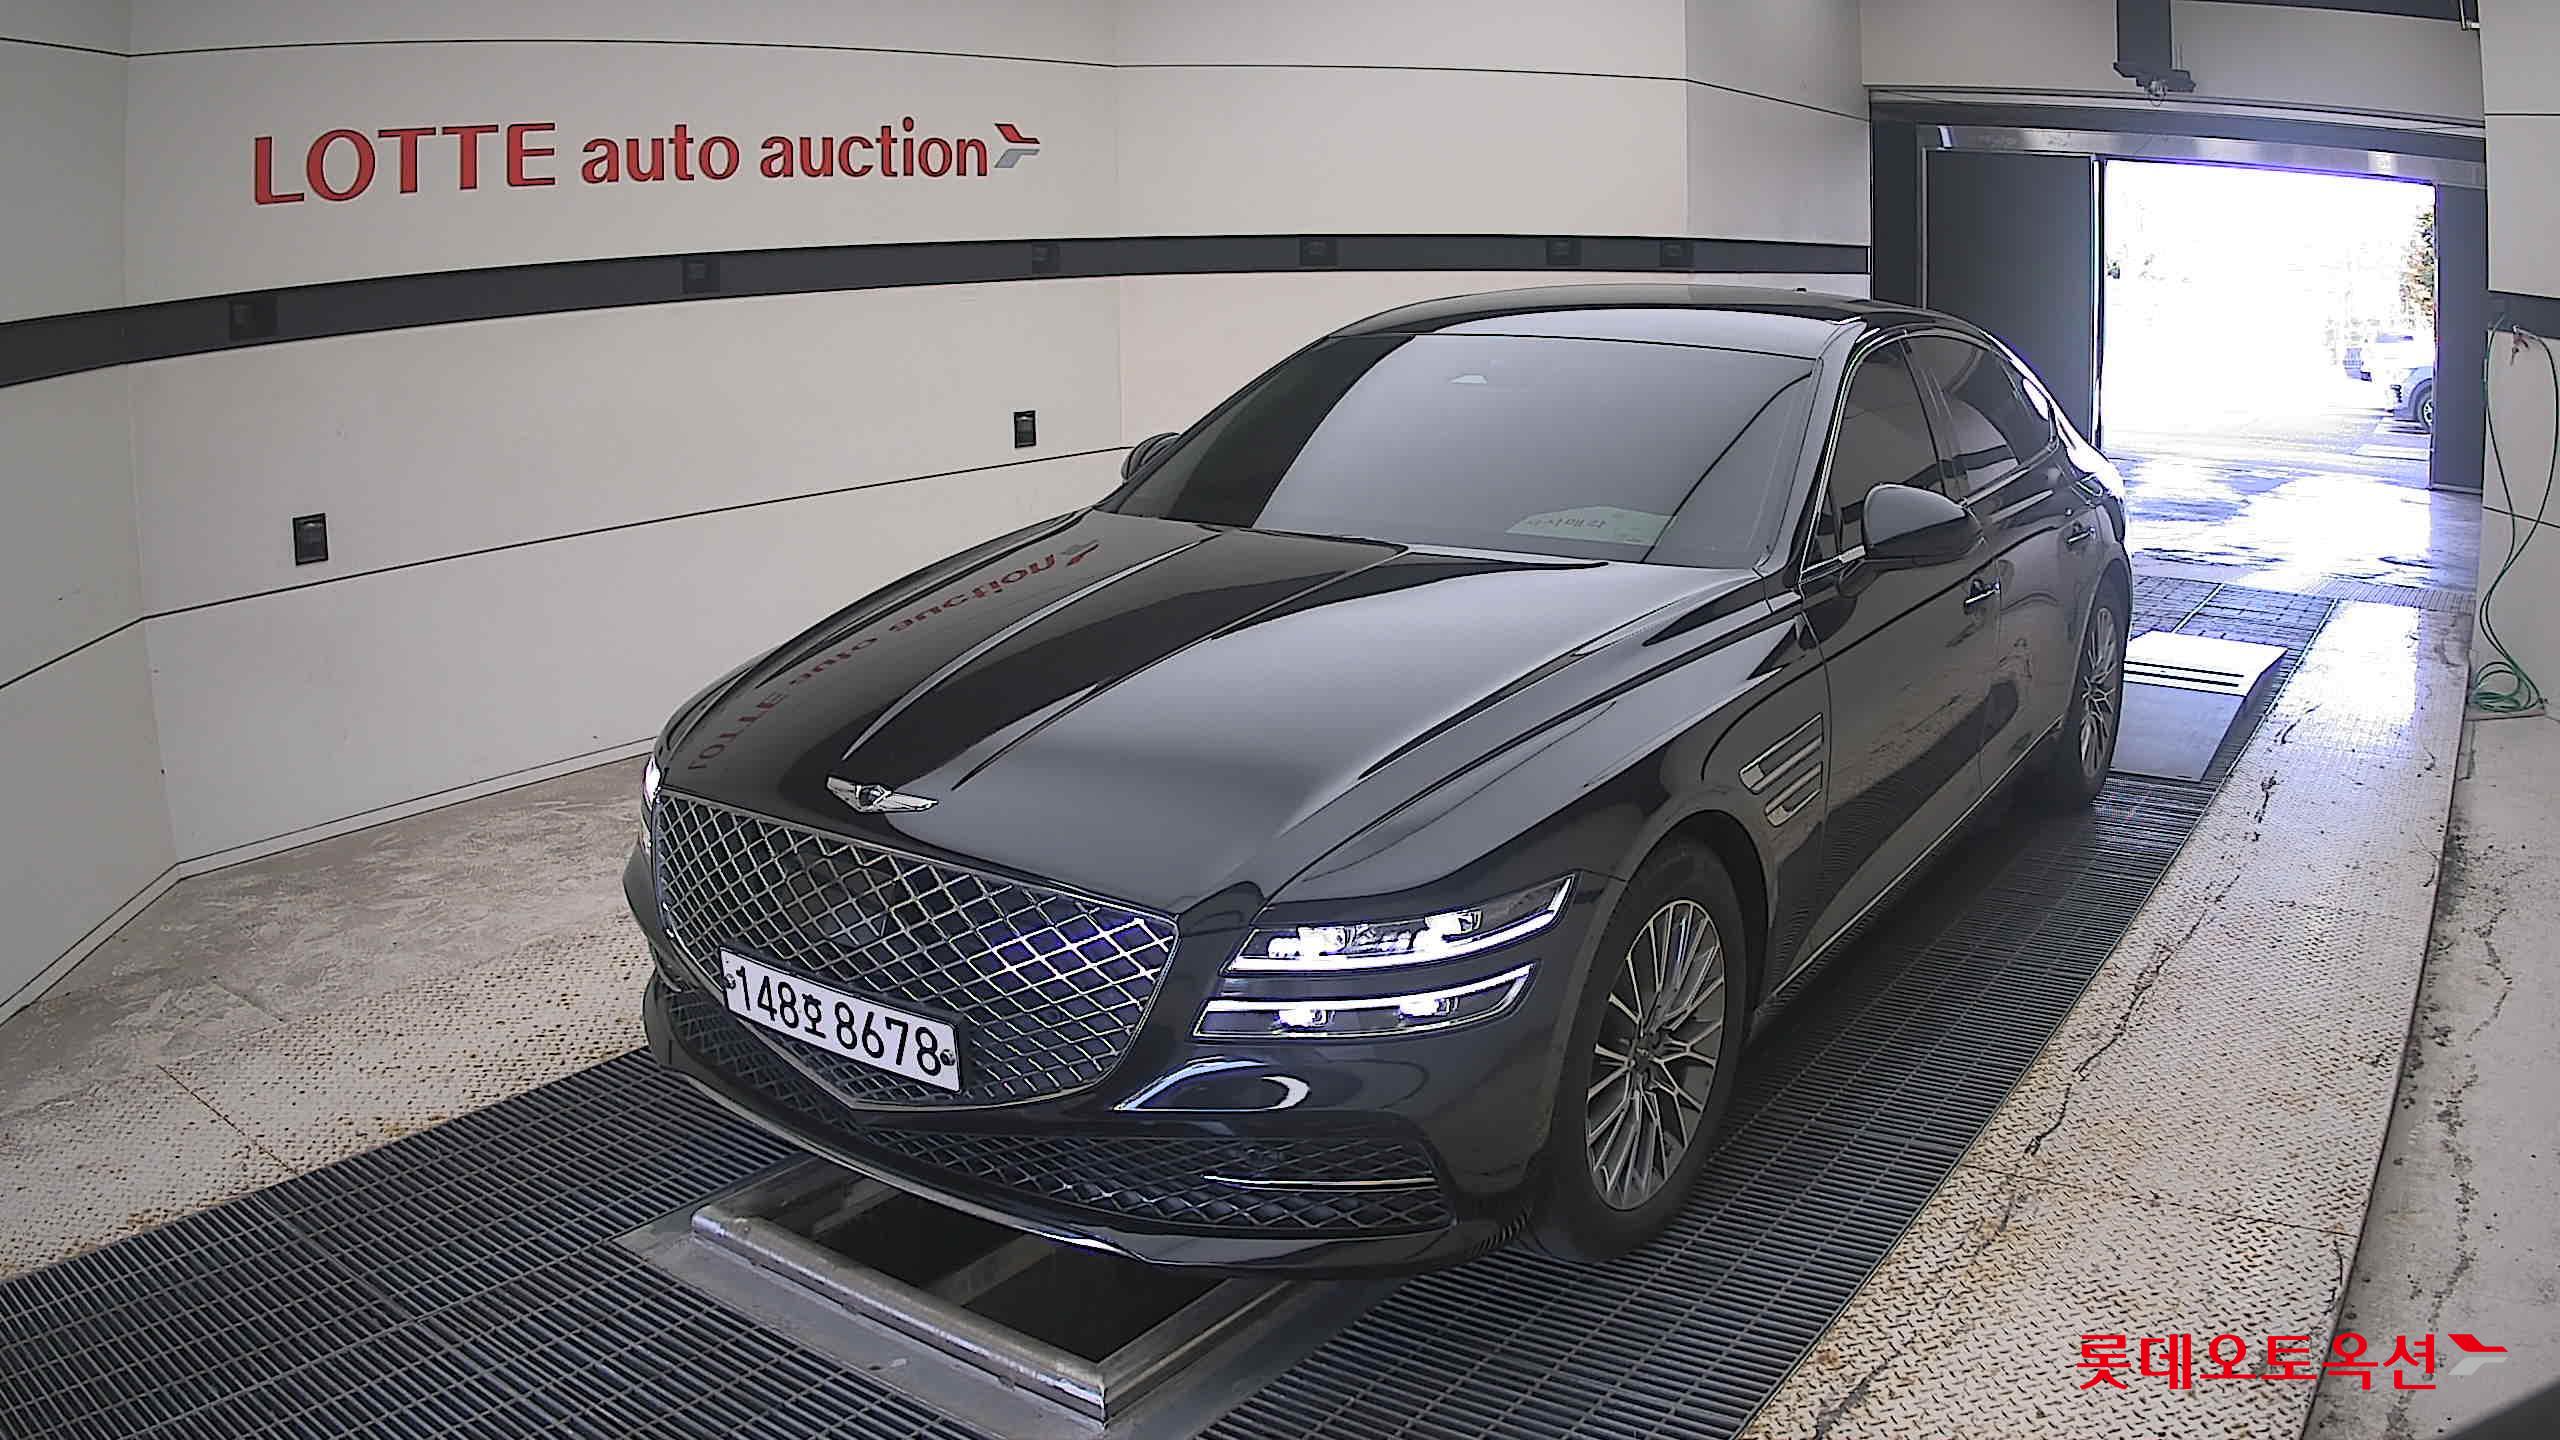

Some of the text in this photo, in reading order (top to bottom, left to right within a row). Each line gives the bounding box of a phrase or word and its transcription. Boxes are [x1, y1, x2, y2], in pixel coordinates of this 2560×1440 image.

[253, 117, 990, 206] LOTTE auto auction
[734, 965, 942, 1077] 148호 8678
